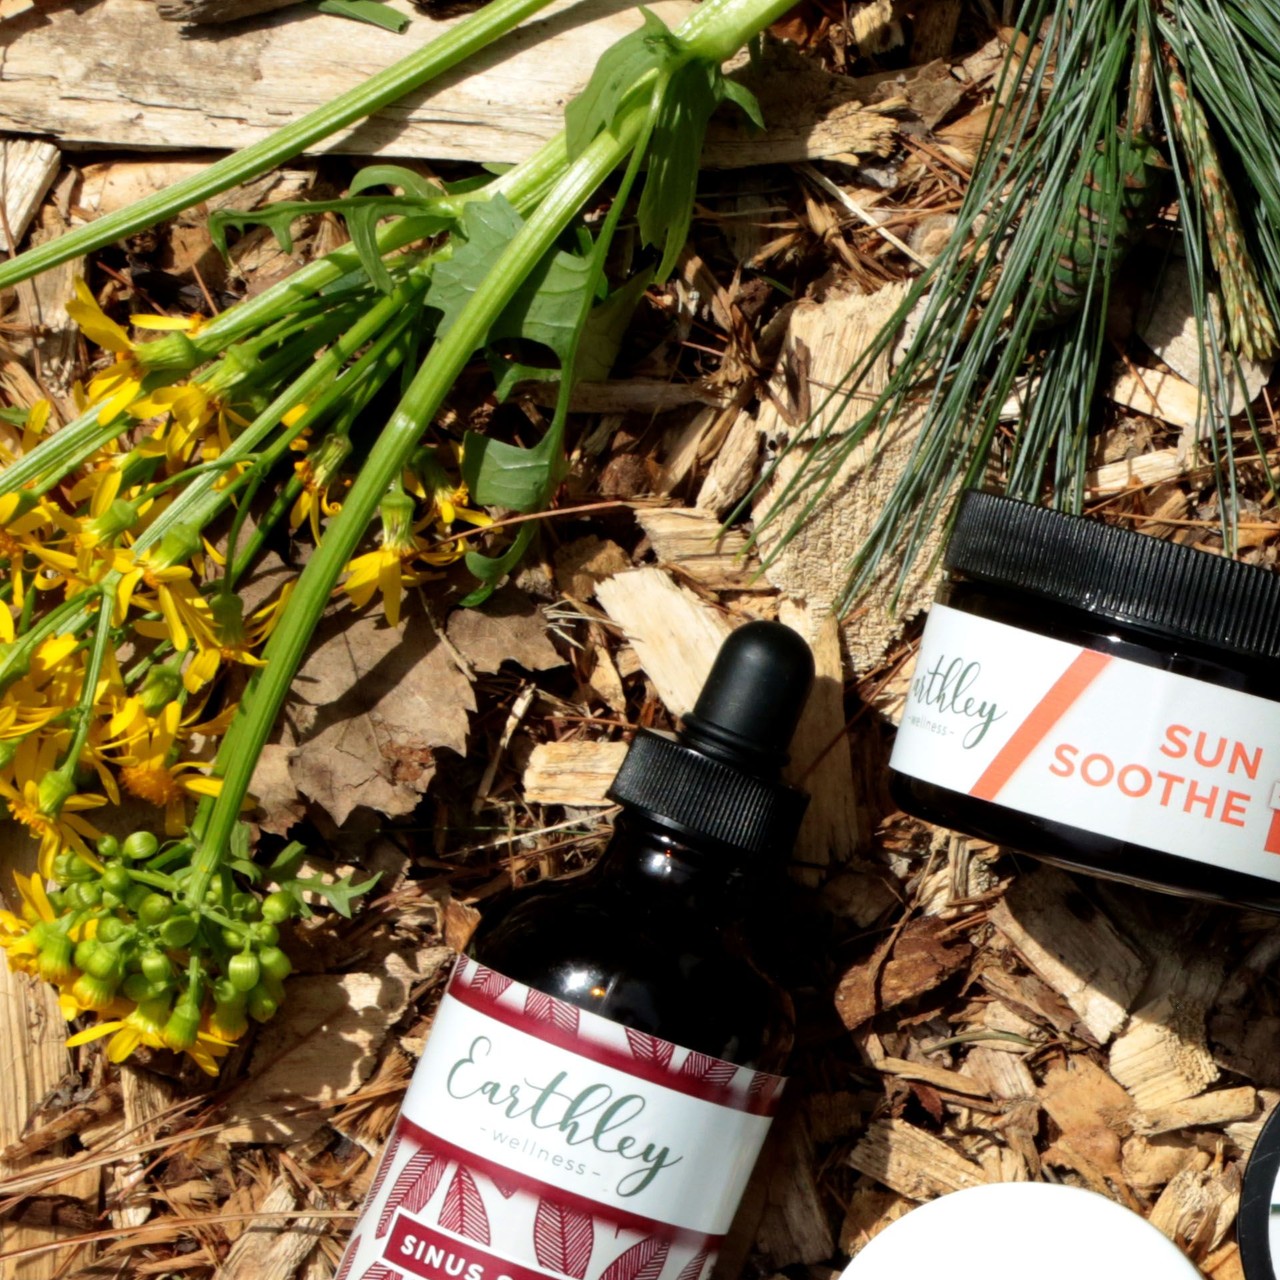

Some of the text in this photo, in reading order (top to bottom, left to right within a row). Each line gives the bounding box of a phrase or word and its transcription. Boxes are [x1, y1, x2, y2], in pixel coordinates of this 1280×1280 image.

[1048, 743, 1251, 827] SOOTHE
[1159, 723, 1263, 780] SUN
[446, 1036, 683, 1198] Earthley
